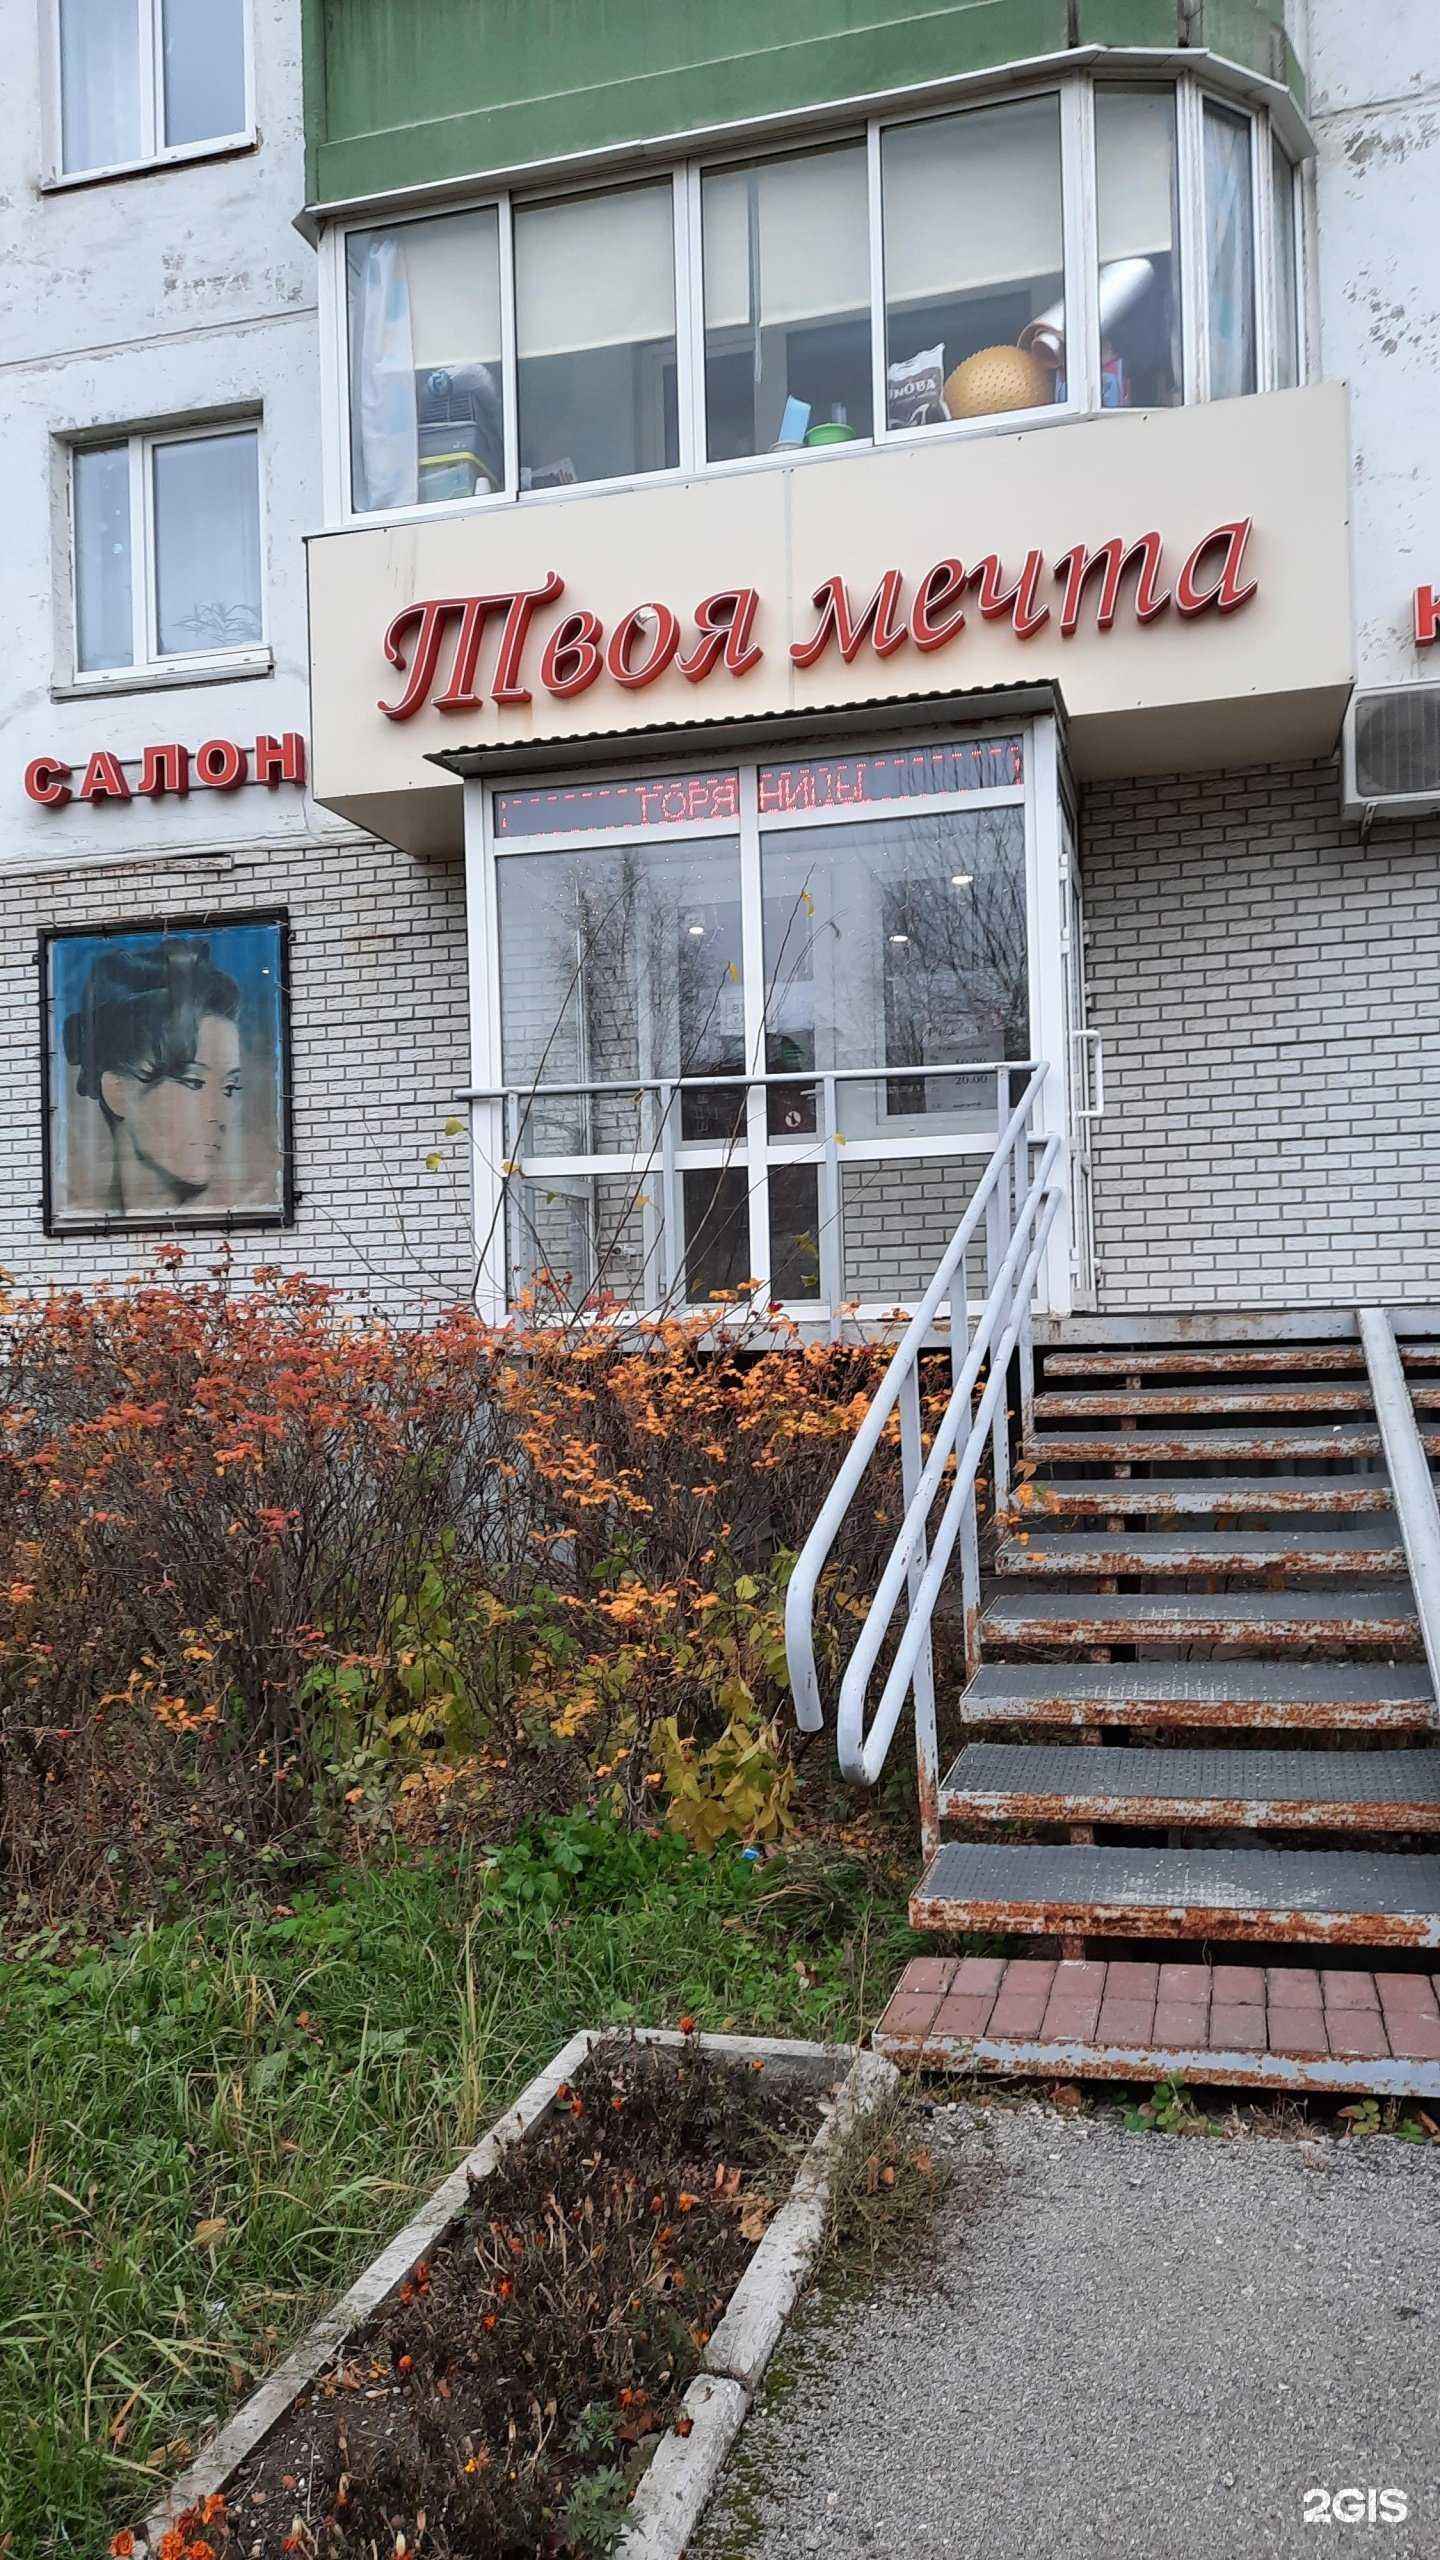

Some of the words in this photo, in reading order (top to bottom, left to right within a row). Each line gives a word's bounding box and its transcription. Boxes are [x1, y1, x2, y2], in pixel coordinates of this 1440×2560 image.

[376, 570, 765, 720] Твоя
[789, 515, 1258, 670] мечта
[24, 732, 308, 807] САЛОН
